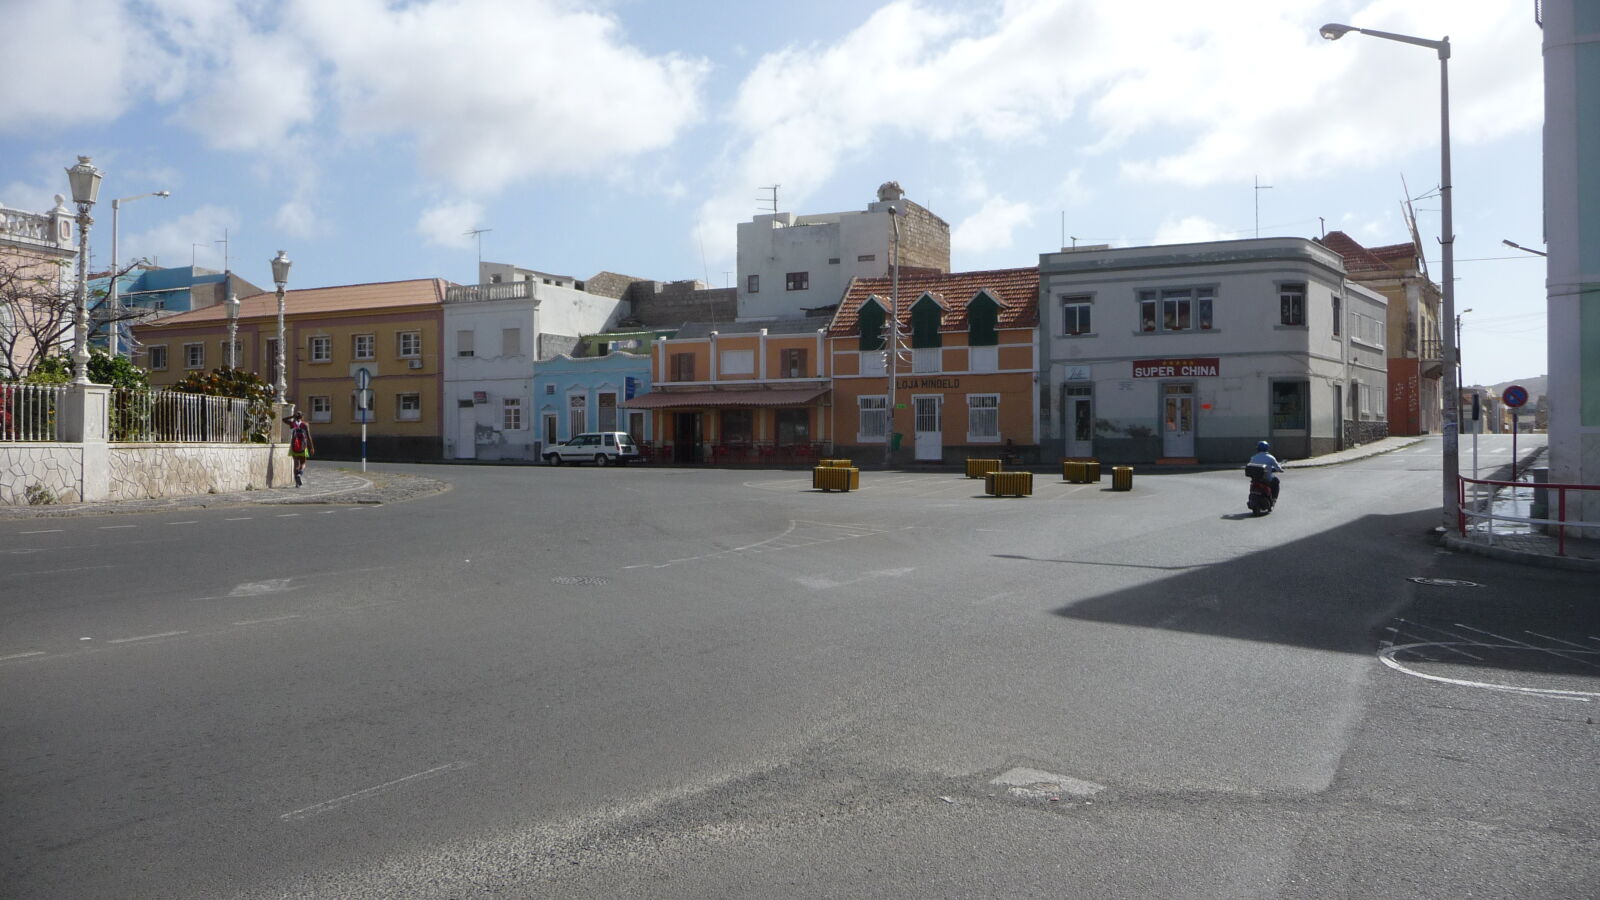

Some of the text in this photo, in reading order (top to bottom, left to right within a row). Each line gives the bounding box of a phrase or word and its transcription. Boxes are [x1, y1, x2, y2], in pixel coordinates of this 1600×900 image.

[1135, 366, 1217, 377] SUPER CHINA
[896, 379, 960, 389] LOJA MINDELO
